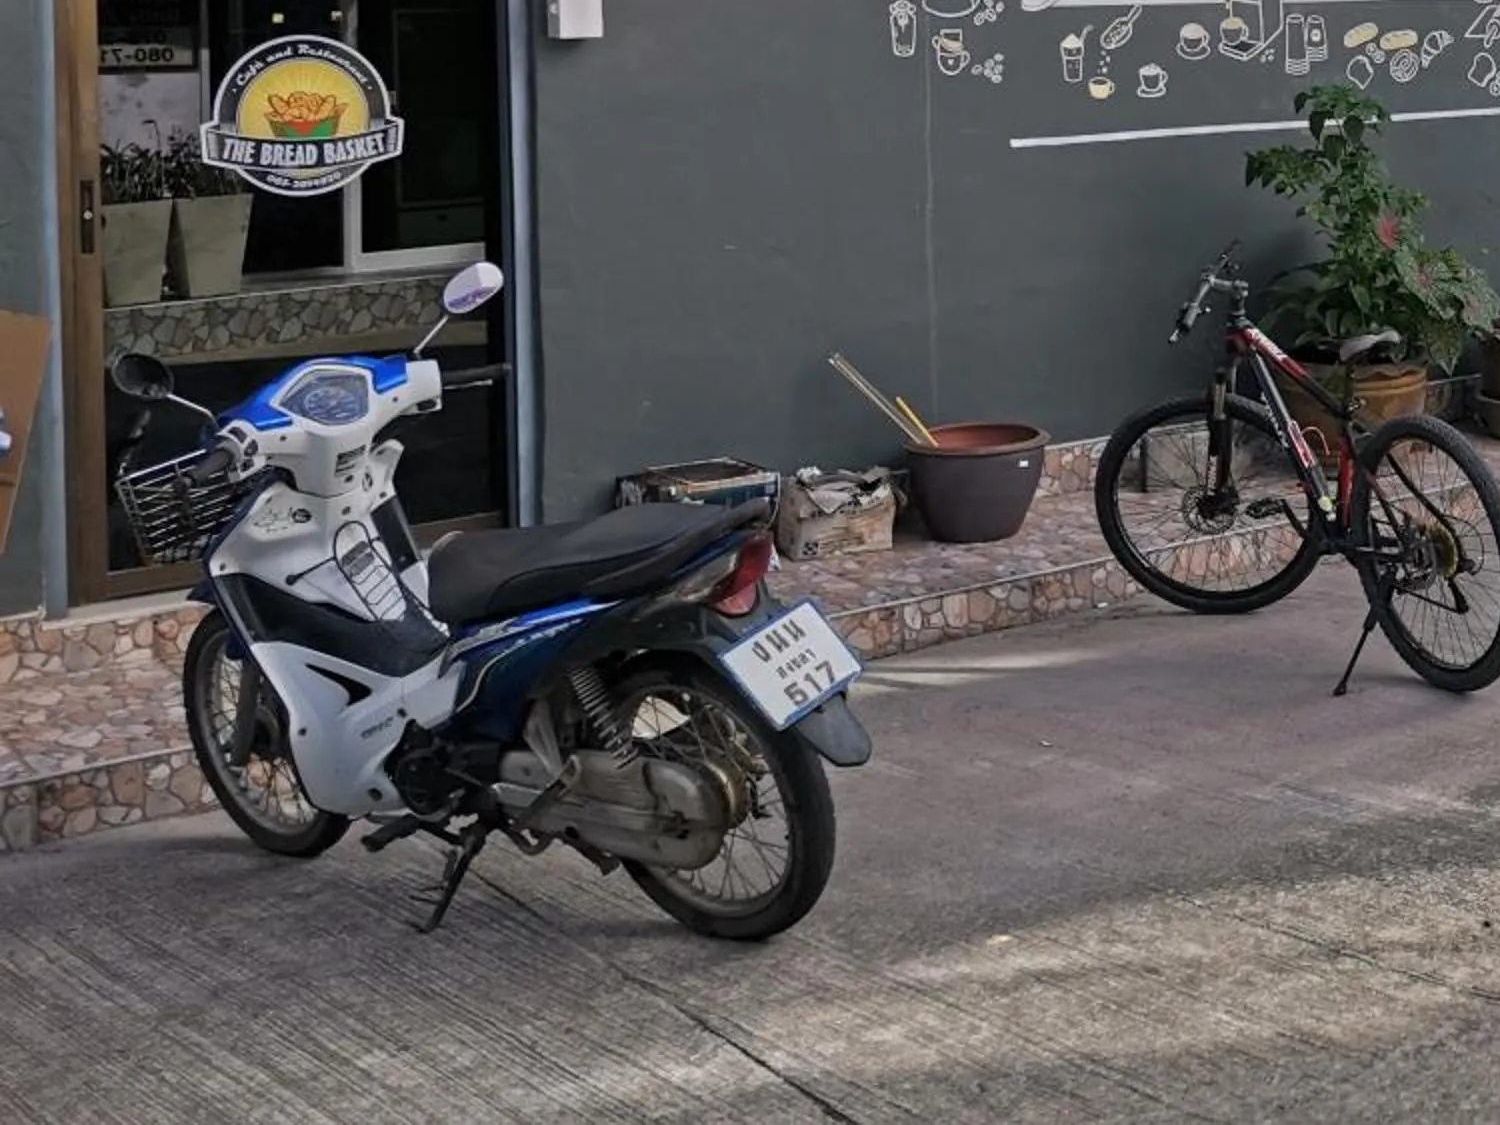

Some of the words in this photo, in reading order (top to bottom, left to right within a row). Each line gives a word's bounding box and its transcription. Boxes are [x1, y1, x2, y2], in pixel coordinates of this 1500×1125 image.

[265, 46, 294, 63] and
[297, 43, 369, 85] Restaurant
[222, 139, 256, 164] THE
[259, 143, 318, 167] BREAD
[322, 132, 386, 163] BASKET
